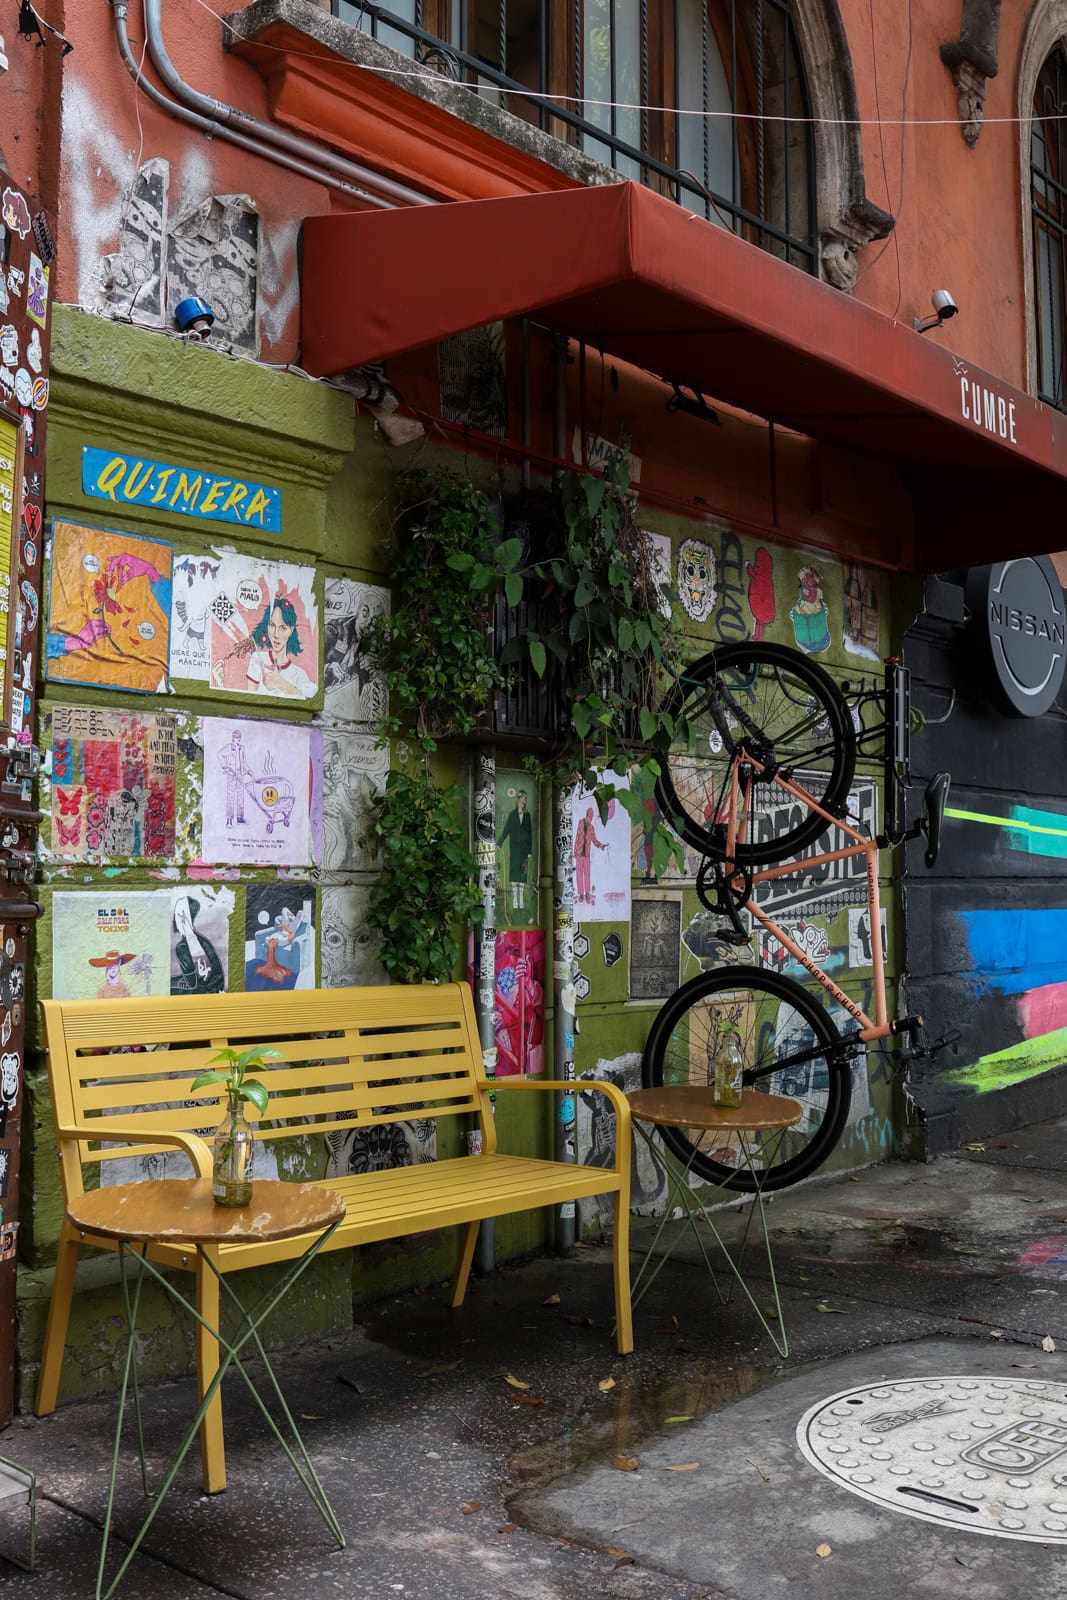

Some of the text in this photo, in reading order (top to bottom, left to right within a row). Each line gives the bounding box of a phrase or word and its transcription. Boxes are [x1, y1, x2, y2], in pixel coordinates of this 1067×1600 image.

[97, 457, 271, 525] QUIMERA
[990, 601, 1065, 645] NISSAN
[178, 658, 210, 668] MARCHIT
[149, 741, 176, 753] AND THAT
[97, 907, 129, 917] EL SOL
[978, 1421, 1067, 1468] CFE
